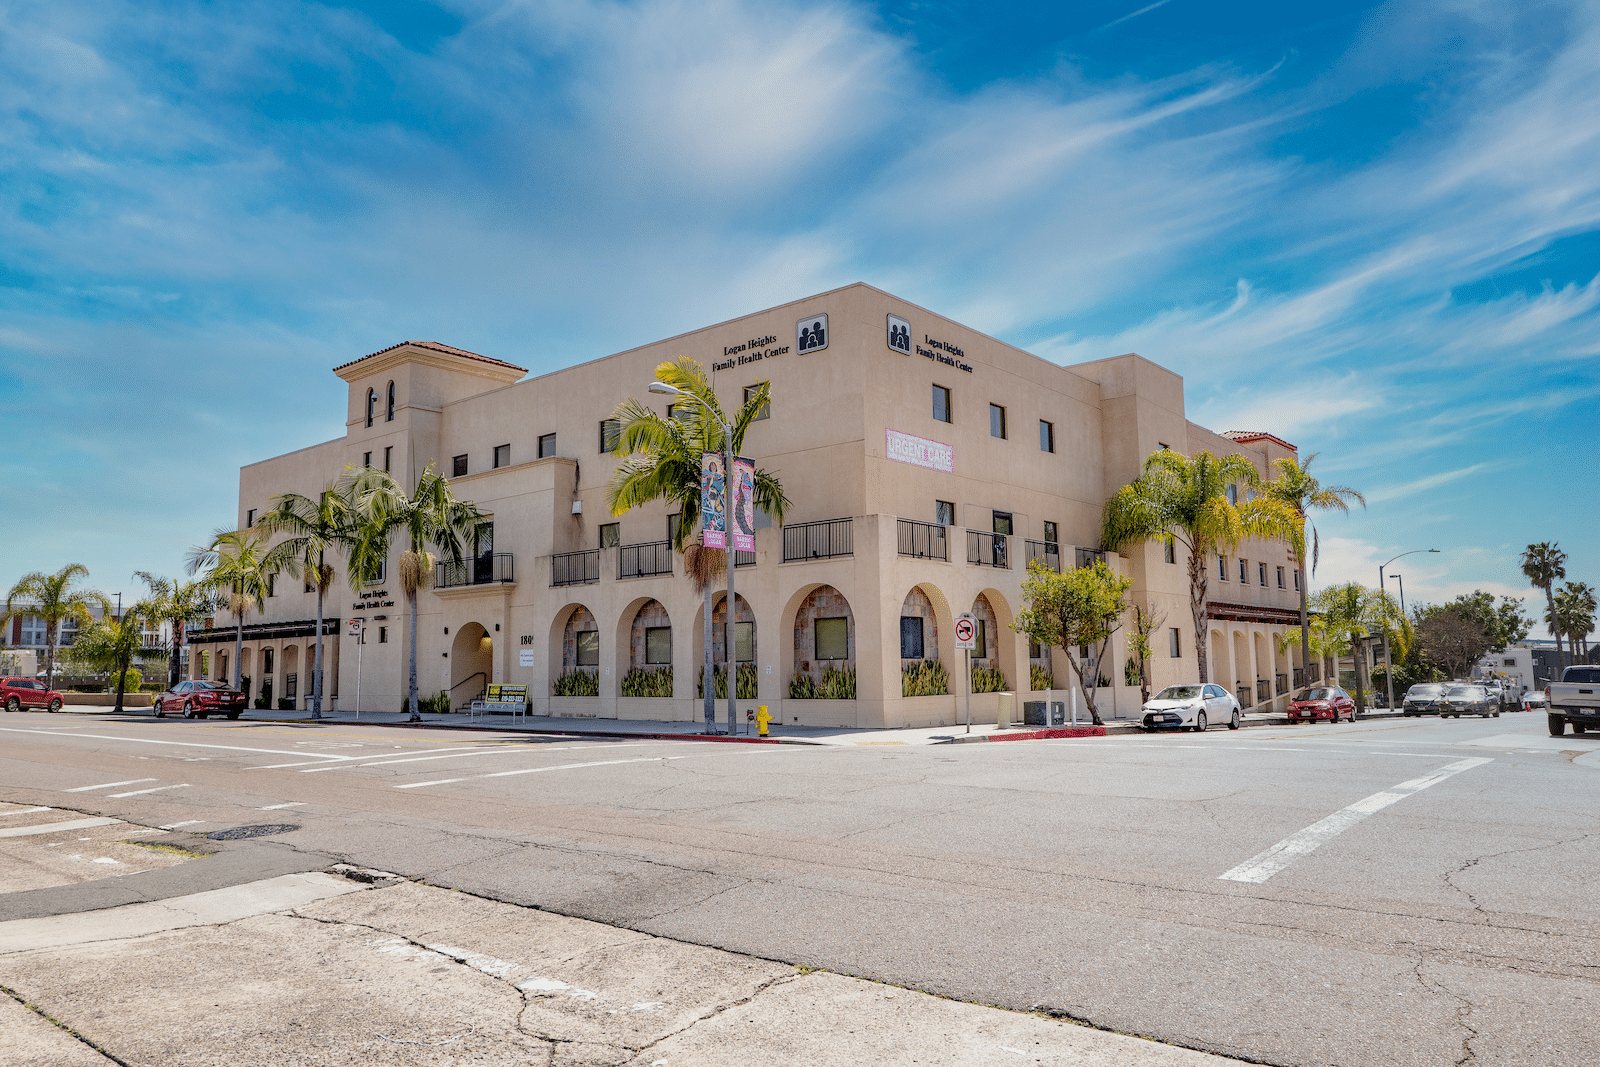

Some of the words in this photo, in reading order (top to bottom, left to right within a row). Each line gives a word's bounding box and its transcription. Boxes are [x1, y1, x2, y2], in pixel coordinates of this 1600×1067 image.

[724, 344, 746, 356] Logan
[748, 335, 777, 349] Heights
[925, 334, 943, 349] Logan
[943, 341, 965, 357] Heights
[712, 358, 736, 372] Family
[738, 352, 763, 366] Health
[764, 346, 789, 358] Center
[916, 344, 935, 361] Family
[936, 352, 955, 367] Health
[955, 360, 973, 373] Center
[887, 436, 925, 460] URGENT
[927, 446, 953, 468] CARE
[366, 601, 380, 609] Health
[372, 589, 388, 598] Heights
